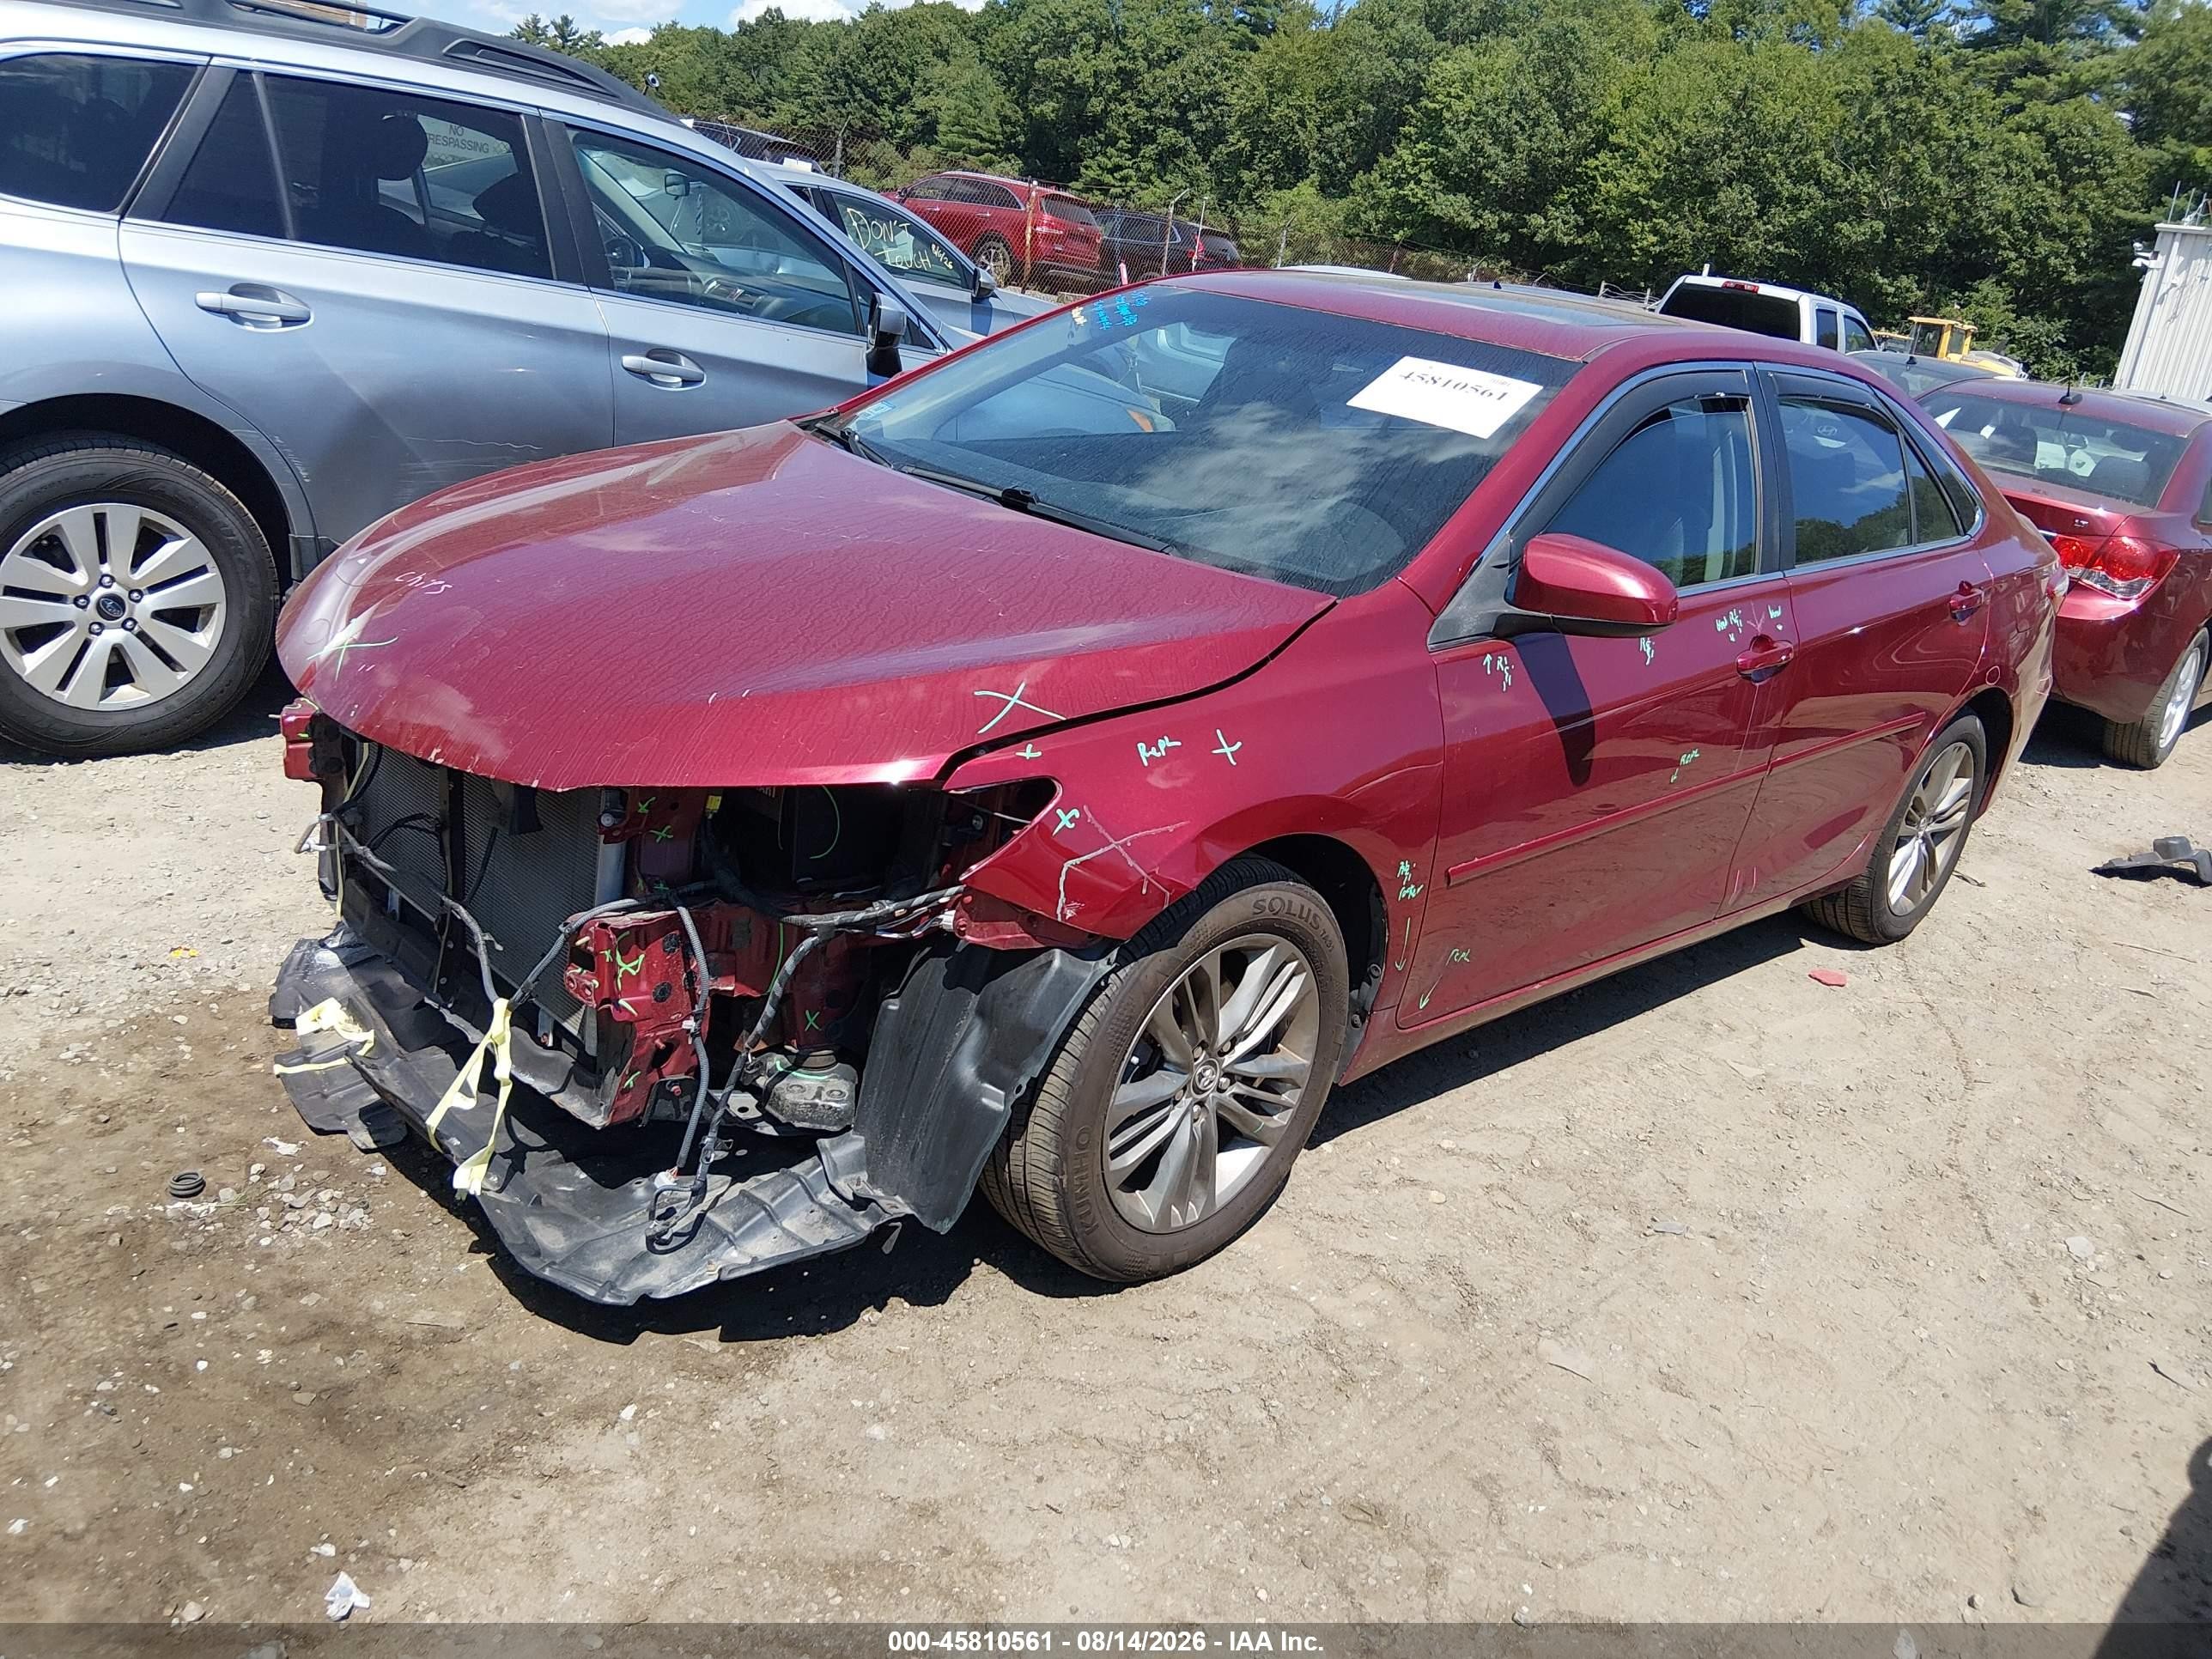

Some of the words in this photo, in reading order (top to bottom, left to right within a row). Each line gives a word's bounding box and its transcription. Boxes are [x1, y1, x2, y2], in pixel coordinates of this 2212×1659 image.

[449, 125, 465, 137] NO
[847, 208, 910, 250] DON'T
[874, 248, 932, 270] TOUCH
[1252, 896, 1323, 930] SOLUS
[1073, 1125, 1100, 1236] KUMHO
